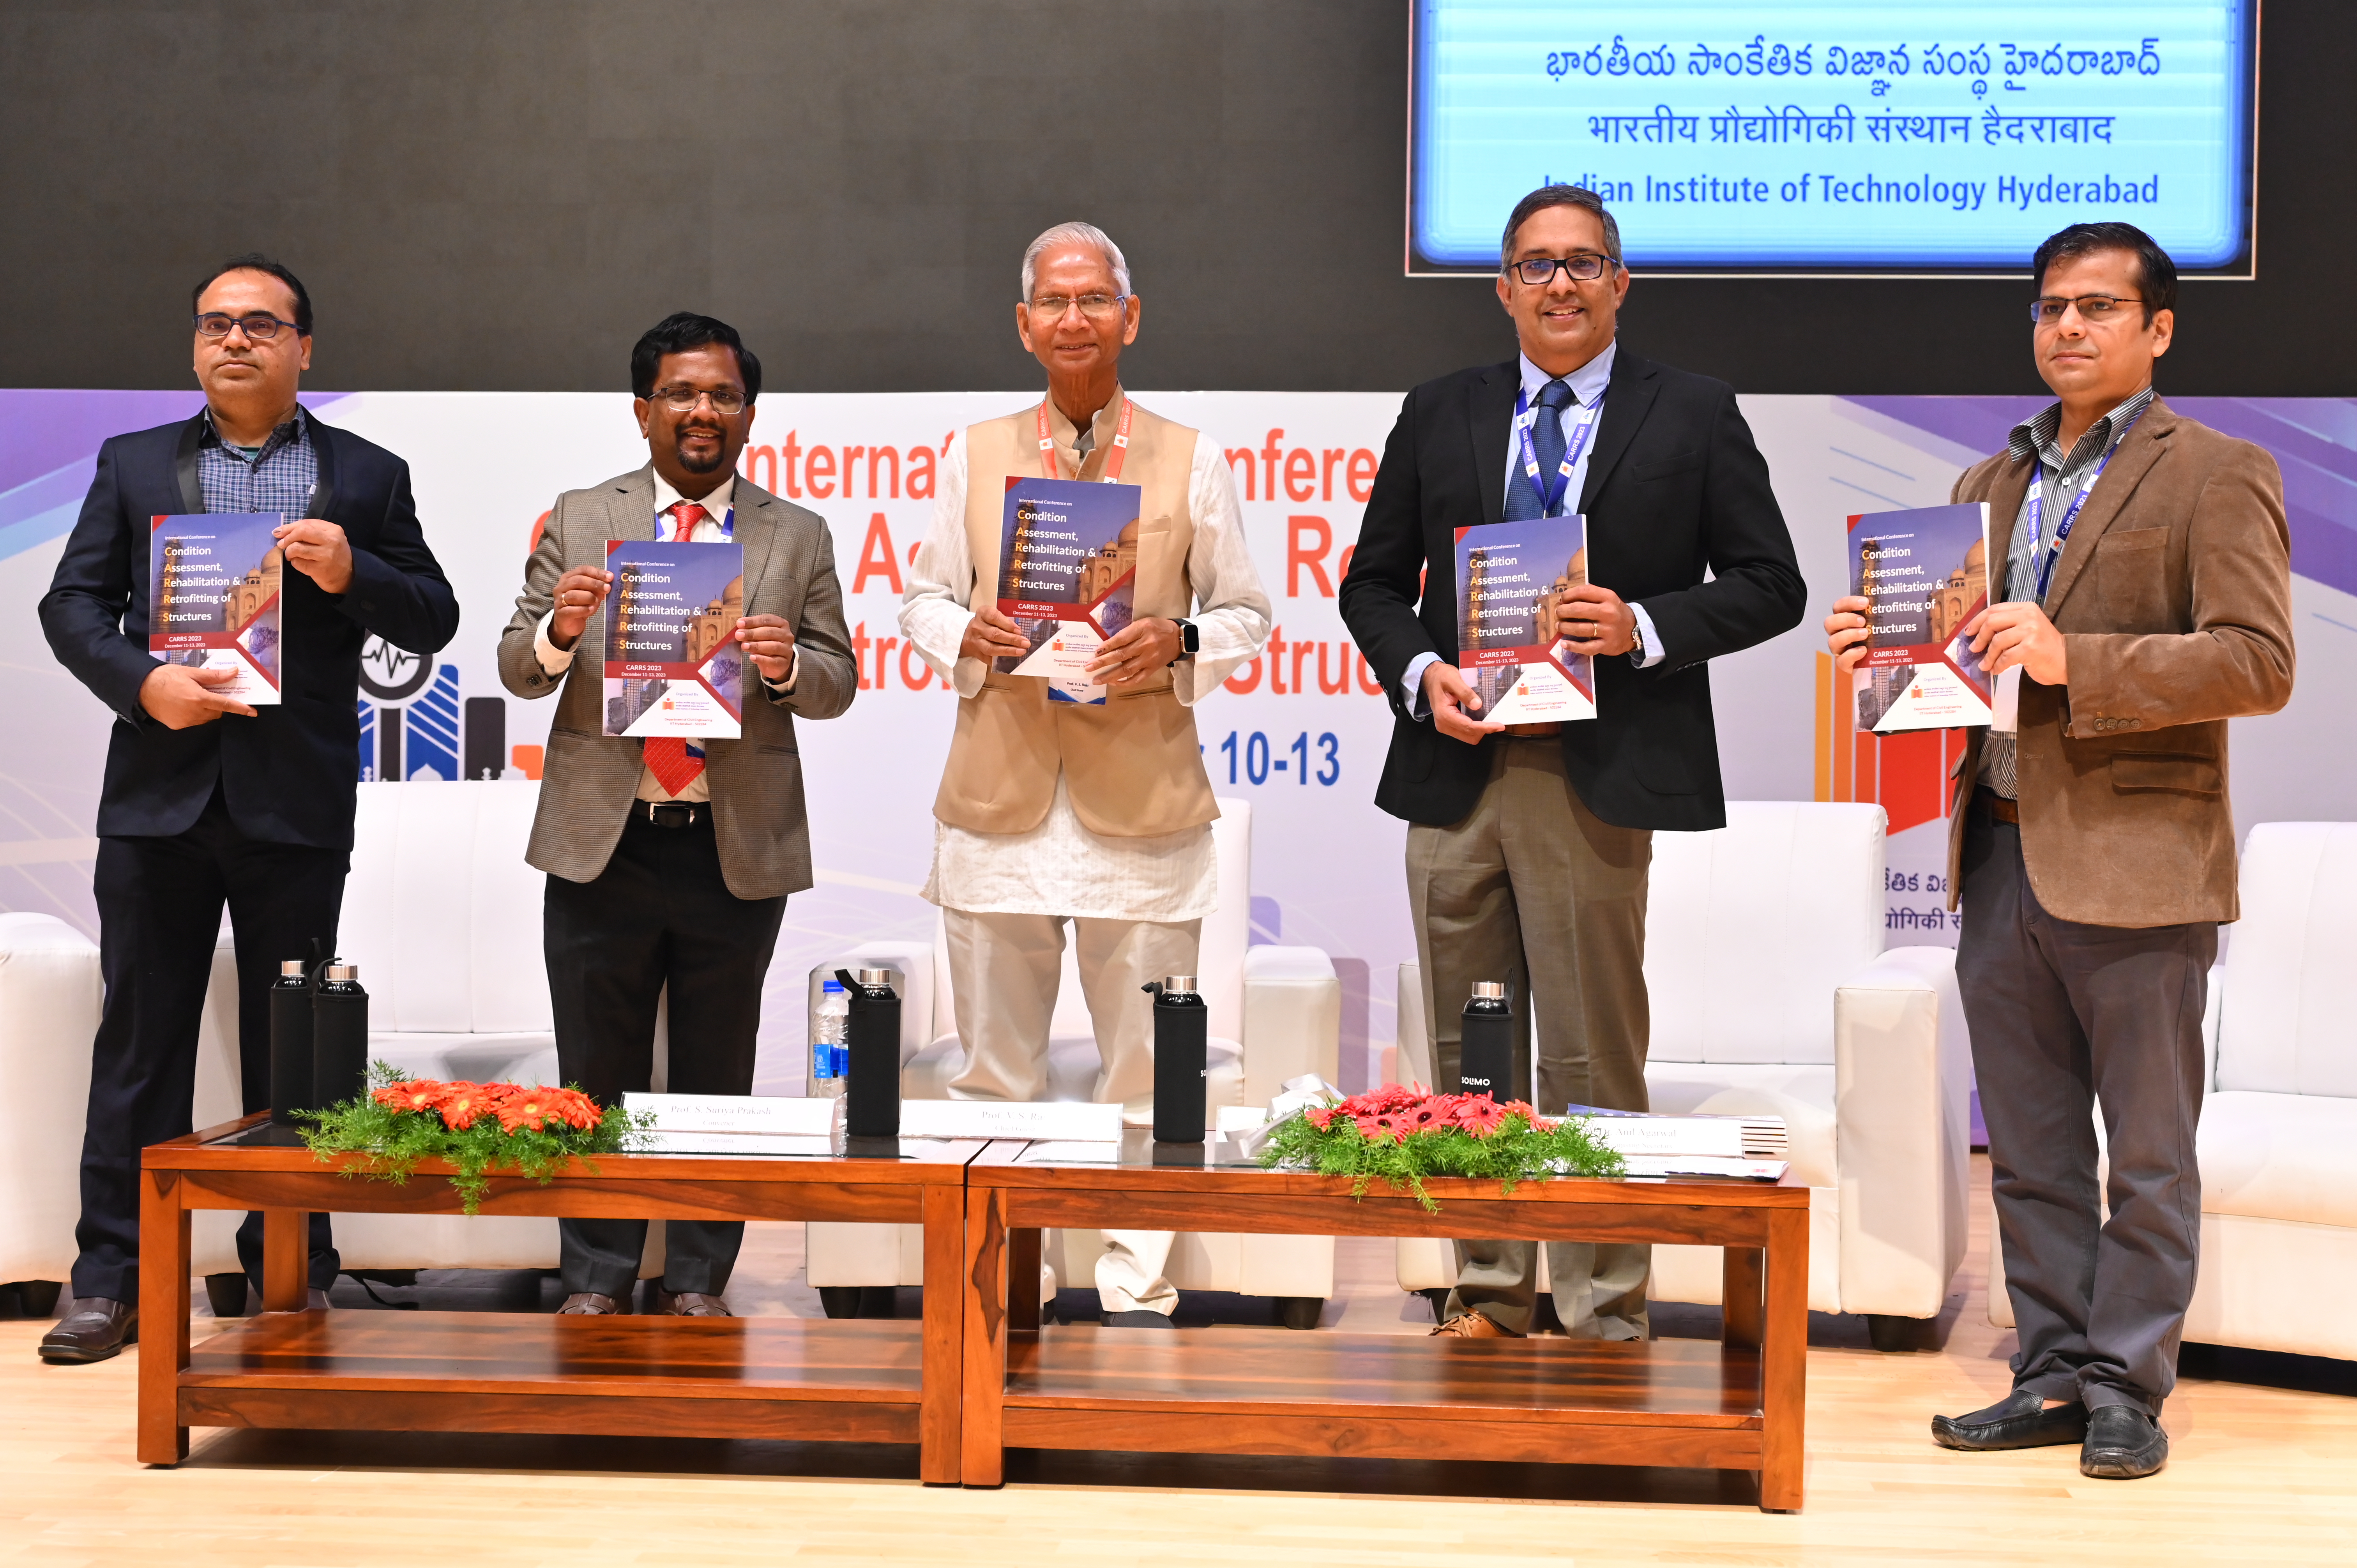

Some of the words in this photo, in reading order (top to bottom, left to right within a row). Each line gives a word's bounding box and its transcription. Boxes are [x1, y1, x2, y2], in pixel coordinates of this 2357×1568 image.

[1546, 35, 1675, 82] భారతీయ
[1687, 34, 1813, 76] సాంకేతిక
[1825, 43, 1910, 97] విజ్ఞాన
[1923, 43, 1990, 101] సంస్థ
[1999, 38, 2160, 91] హైదరాబాద్
[1588, 104, 1700, 143] भारतीय
[1709, 104, 1856, 143] प्रौद्योगिकी
[1864, 107, 1972, 143] संस्थान
[1981, 105, 2116, 146] हैदराबाद
[1646, 174, 1769, 202] Institute
[1781, 173, 1811, 202] of
[1818, 173, 1986, 211] Technology
[1998, 174, 2158, 211] Hyderabad
[1567, 440, 1580, 461] CARRS
[1576, 426, 1585, 439] 2023
[1524, 441, 1533, 461] CARRS
[1018, 510, 1066, 522] Condition
[2061, 510, 2078, 534] CARRS
[2075, 494, 2087, 510] 2023
[1016, 527, 1078, 542] Assessment,
[164, 546, 211, 556] Condition
[1016, 542, 1084, 556] Rehabilitation
[1088, 548, 1096, 557] &
[1862, 547, 1910, 560] Condition
[164, 563, 223, 572] Assessment,
[1014, 560, 1072, 574] Retrofitting
[1076, 564, 1087, 574] of
[1470, 556, 1517, 568] Condition
[1863, 564, 1924, 579] Assessment,
[164, 577, 229, 587] Rehabilitation
[232, 577, 241, 585] &
[621, 573, 670, 583] Condition
[1470, 572, 1530, 586] Assessment,
[1012, 578, 1065, 591] Structures
[1864, 581, 1932, 595] Rehabilitation
[1935, 579, 1944, 589] &
[164, 594, 218, 604] Retrofitting
[221, 593, 231, 602] of
[620, 590, 683, 602] Assessment,
[1471, 588, 1538, 601] Rehabilitation
[1541, 585, 1549, 595] &
[620, 605, 690, 616] Rehabilitation
[693, 606, 701, 616] &
[1472, 606, 1528, 619] Retrofitting
[1531, 603, 1541, 613] of
[1864, 601, 1922, 614] Retrofitting
[1924, 599, 1935, 609] of
[163, 613, 211, 622] Structures
[620, 622, 679, 634] Retrofitting
[681, 623, 692, 632] of
[1472, 627, 1523, 637] Structures
[1865, 623, 1917, 635] Structures
[620, 640, 672, 650] Structures
[1221, 731, 1340, 786] 10-13
[1461, 1076, 1490, 1086] SOLIMO
[706, 1106, 734, 1116] Suriya
[982, 1111, 1003, 1119] Prof.
[1638, 1128, 1676, 1138] Agarwal
